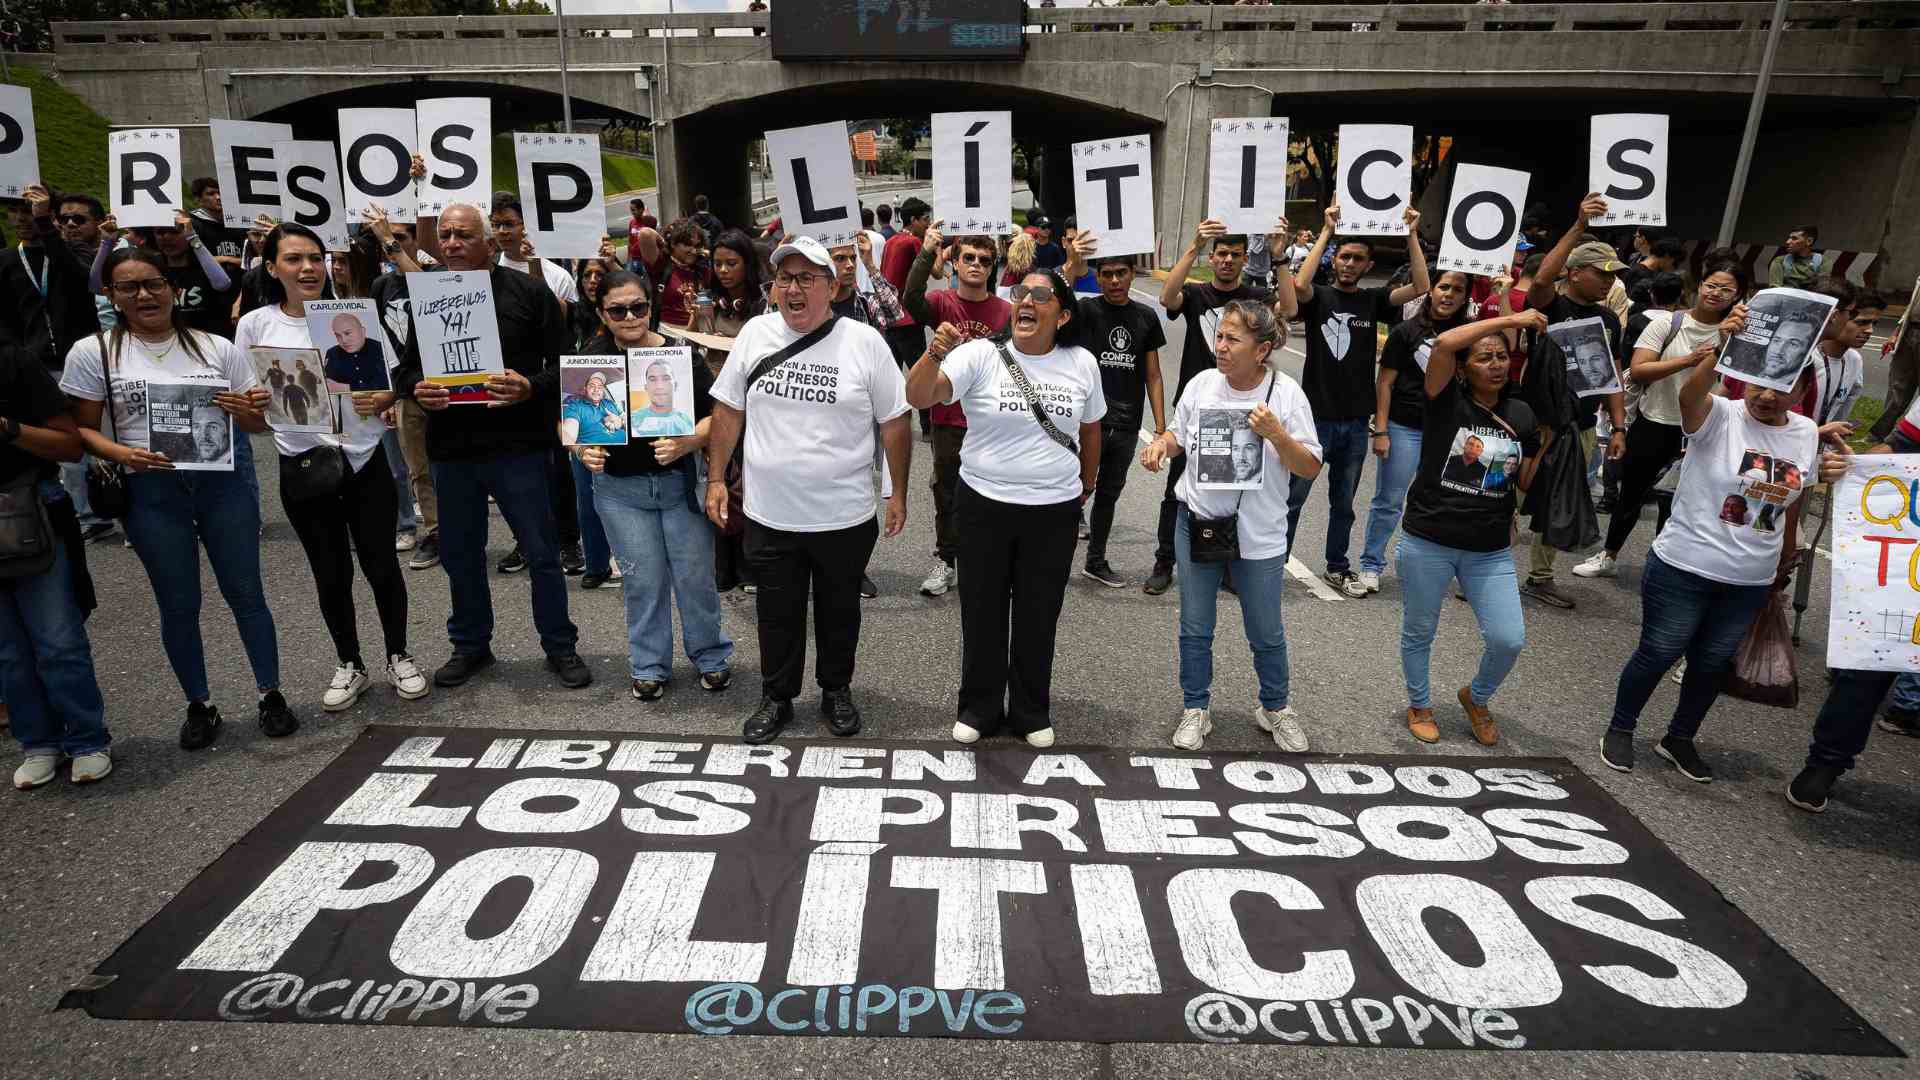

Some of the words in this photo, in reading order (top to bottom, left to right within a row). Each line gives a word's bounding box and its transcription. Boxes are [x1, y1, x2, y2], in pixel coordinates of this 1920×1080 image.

[120, 151, 173, 206] R
[231, 145, 281, 206] E
[347, 133, 412, 197] O
[430, 124, 478, 190] S
[964, 121, 990, 209] Í
[1240, 145, 1257, 209] I
[1347, 149, 1404, 211] C
[1604, 138, 1656, 201] S
[287, 165, 331, 227] S
[532, 161, 594, 232] P
[791, 157, 848, 225] L
[1085, 163, 1140, 231] T
[1451, 190, 1517, 251] O
[310, 303, 344, 311] CARLOS
[345, 302, 367, 310] VIDAL
[440, 311, 471, 337] YA!
[755, 378, 837, 404] POLÍTICOS
[764, 367, 785, 380] OS
[786, 370, 838, 388] PRESOS
[809, 363, 839, 375] TODOS
[382, 736, 977, 782] LIBEREN
[1022, 753, 1107, 787] A
[1129, 757, 1570, 801] TODOS
[323, 772, 758, 836] LOS
[809, 785, 1630, 866] PRESOS
[175, 840, 1749, 1011] POLÍTICOS
